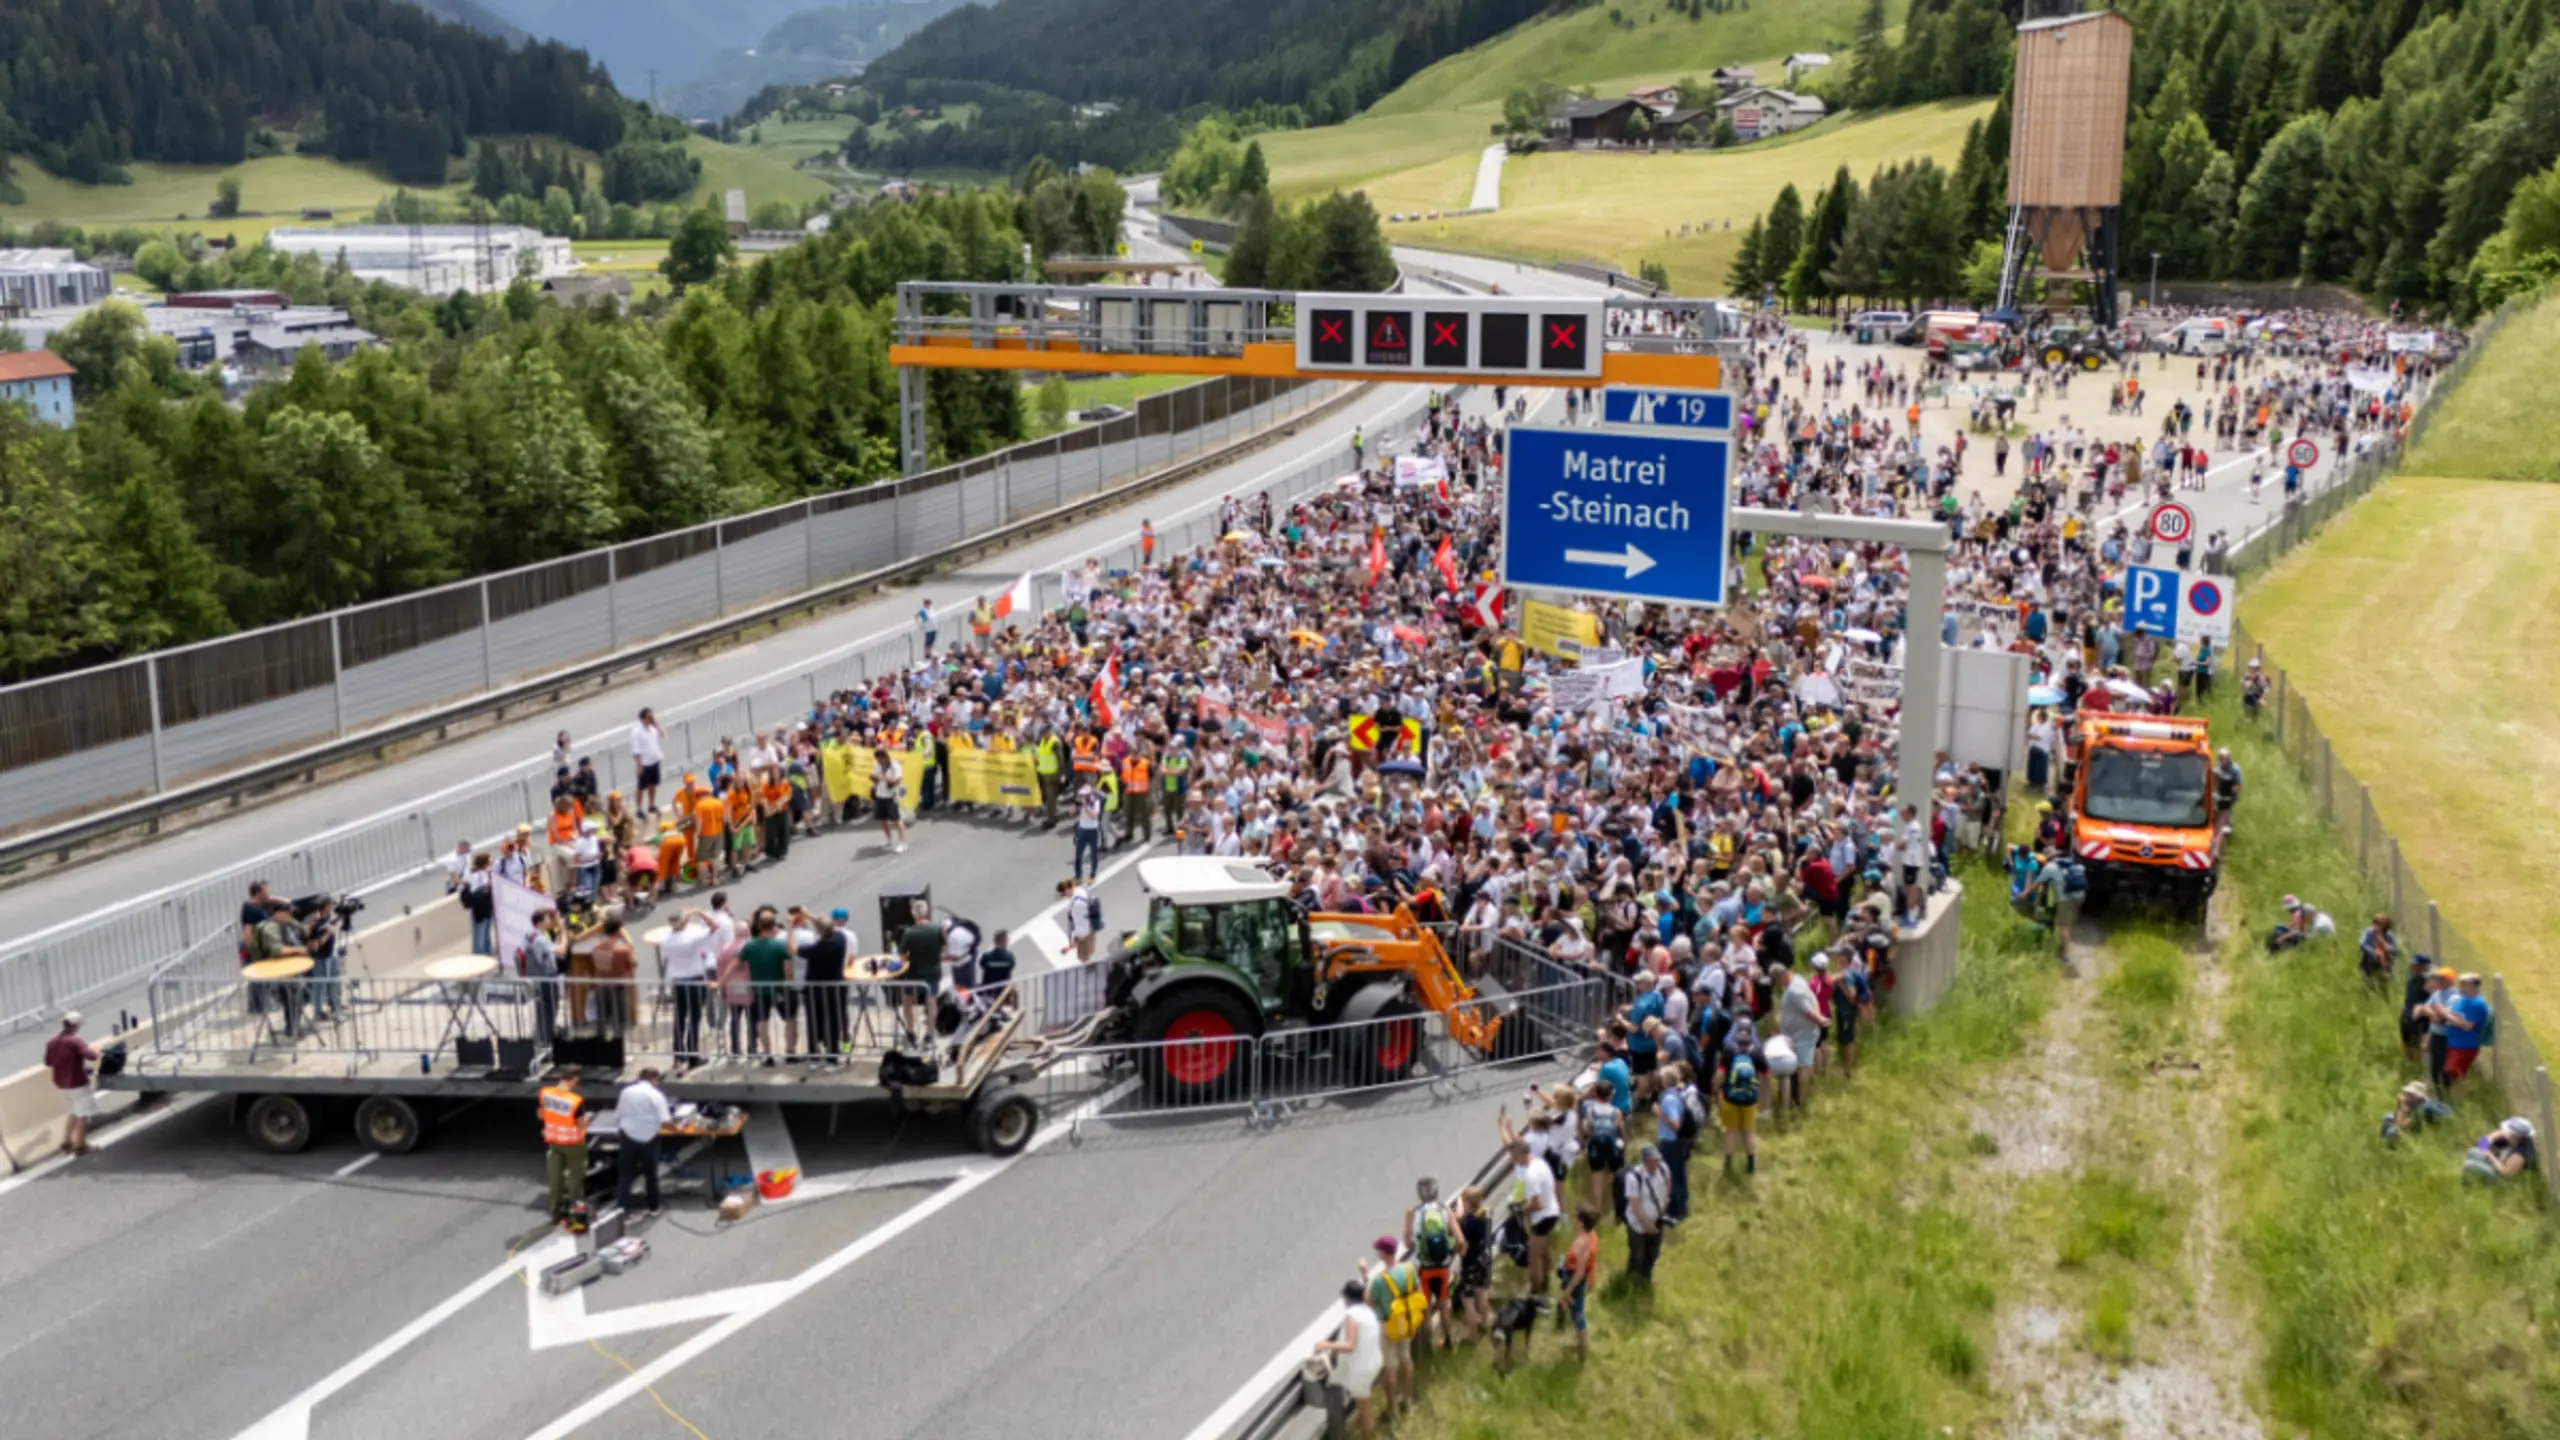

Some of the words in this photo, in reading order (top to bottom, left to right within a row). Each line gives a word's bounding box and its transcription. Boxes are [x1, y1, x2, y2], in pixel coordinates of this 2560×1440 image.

[1675, 398, 1706, 424] 19
[1563, 449, 1667, 486] Matrei
[1538, 490, 1690, 532] -Steinach
[2160, 512, 2183, 533] 80
[2133, 570, 2161, 613] P
